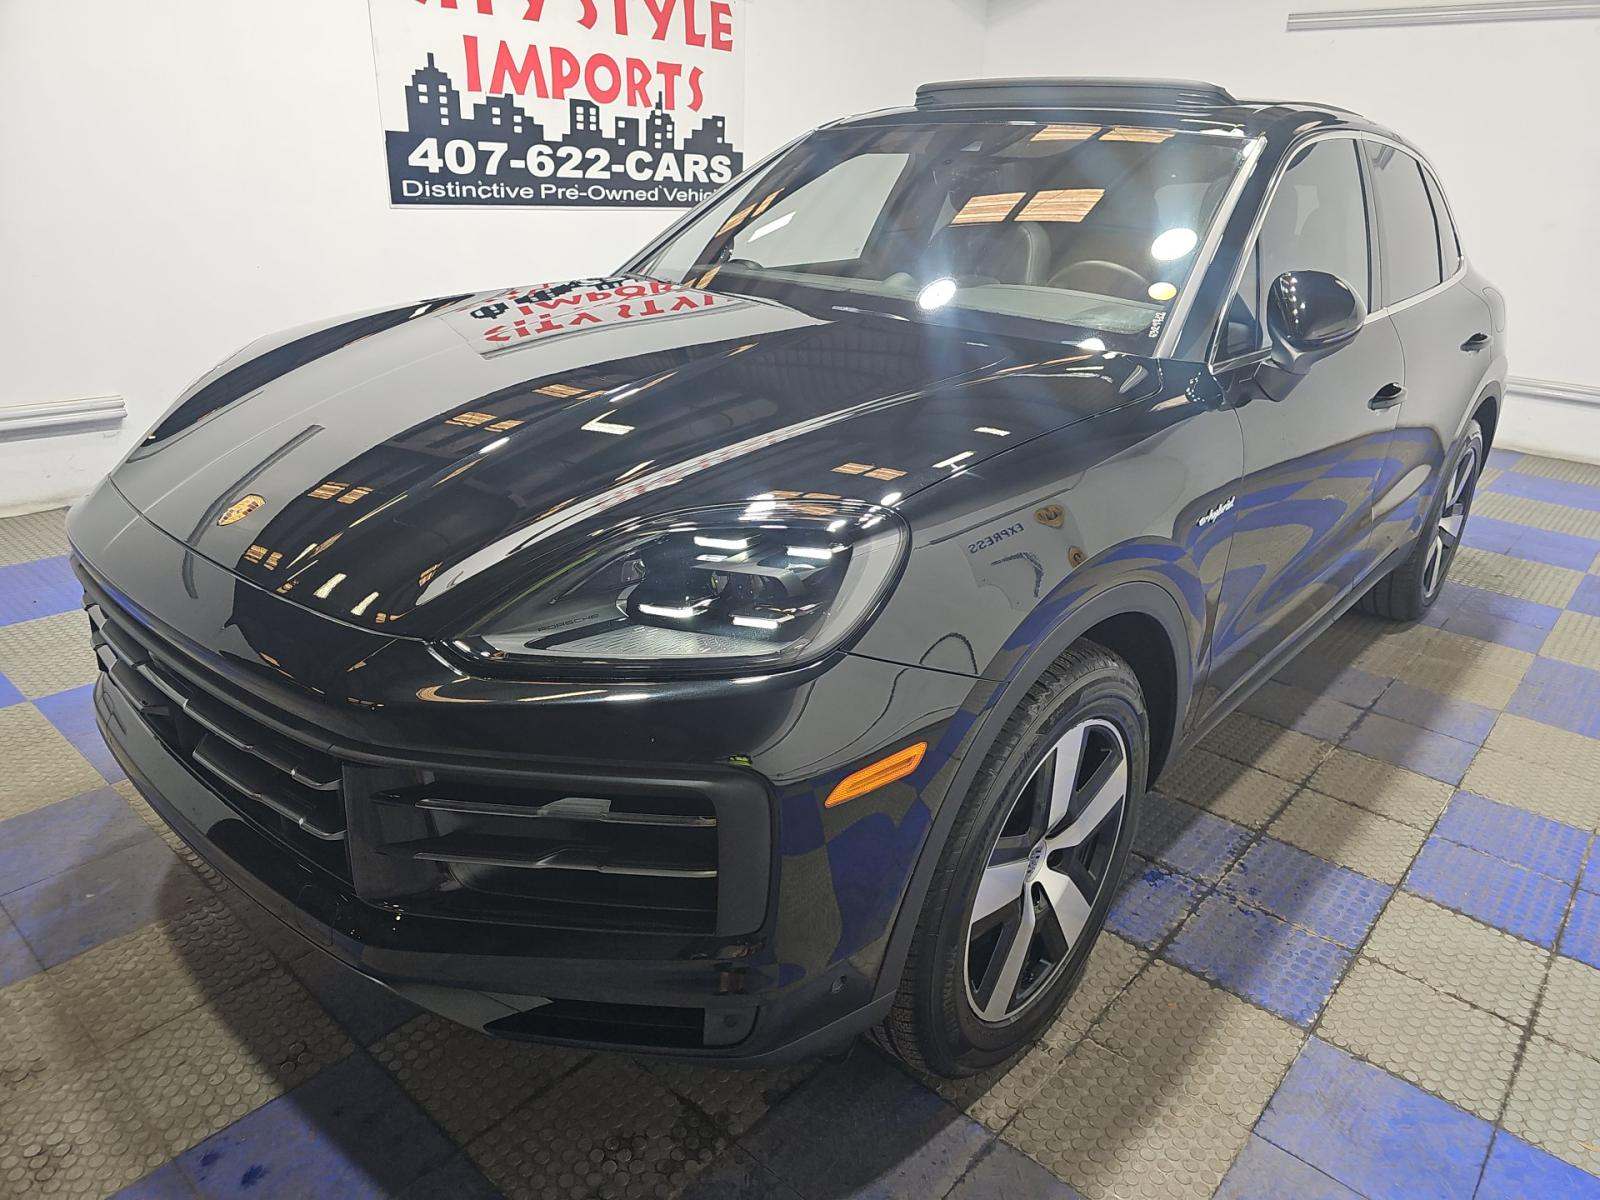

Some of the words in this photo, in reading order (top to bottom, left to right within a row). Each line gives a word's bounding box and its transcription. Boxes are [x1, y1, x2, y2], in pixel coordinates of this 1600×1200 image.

[463, 35, 704, 112] IMPORTS
[408, 137, 732, 184] 407-622-CARS
[402, 180, 534, 199] Distinctive
[540, 183, 659, 202] Pre-Owned
[663, 187, 717, 202] Vehic
[537, 613, 600, 632] PORSCHE
